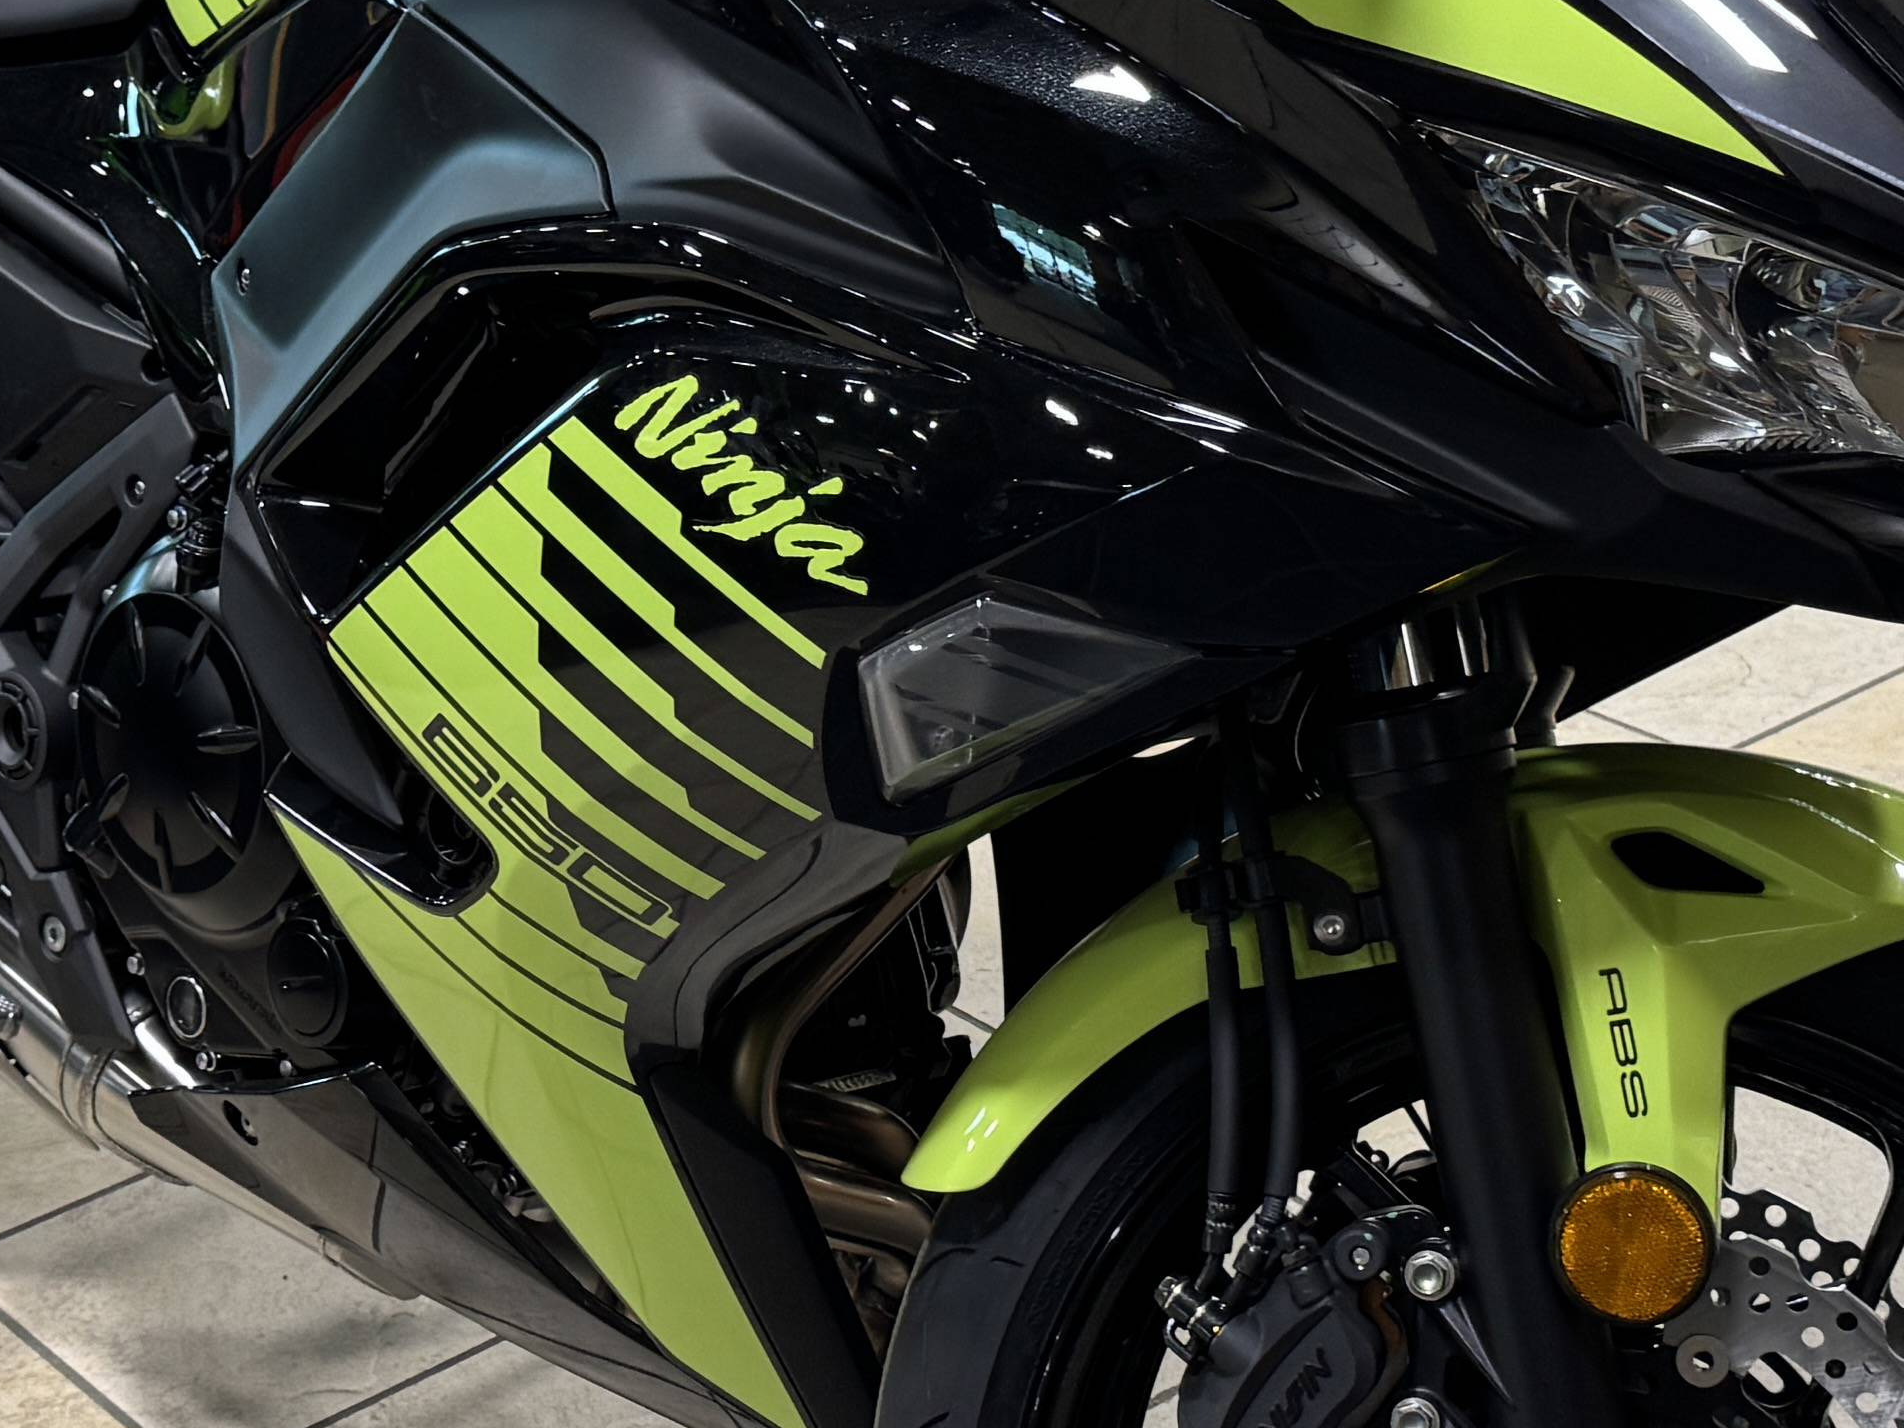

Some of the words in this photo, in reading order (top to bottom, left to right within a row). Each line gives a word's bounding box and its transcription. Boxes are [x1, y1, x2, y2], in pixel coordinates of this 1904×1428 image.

[613, 373, 869, 597] Ninja
[422, 712, 674, 926] 650
[1597, 966, 1649, 1120] ABS
